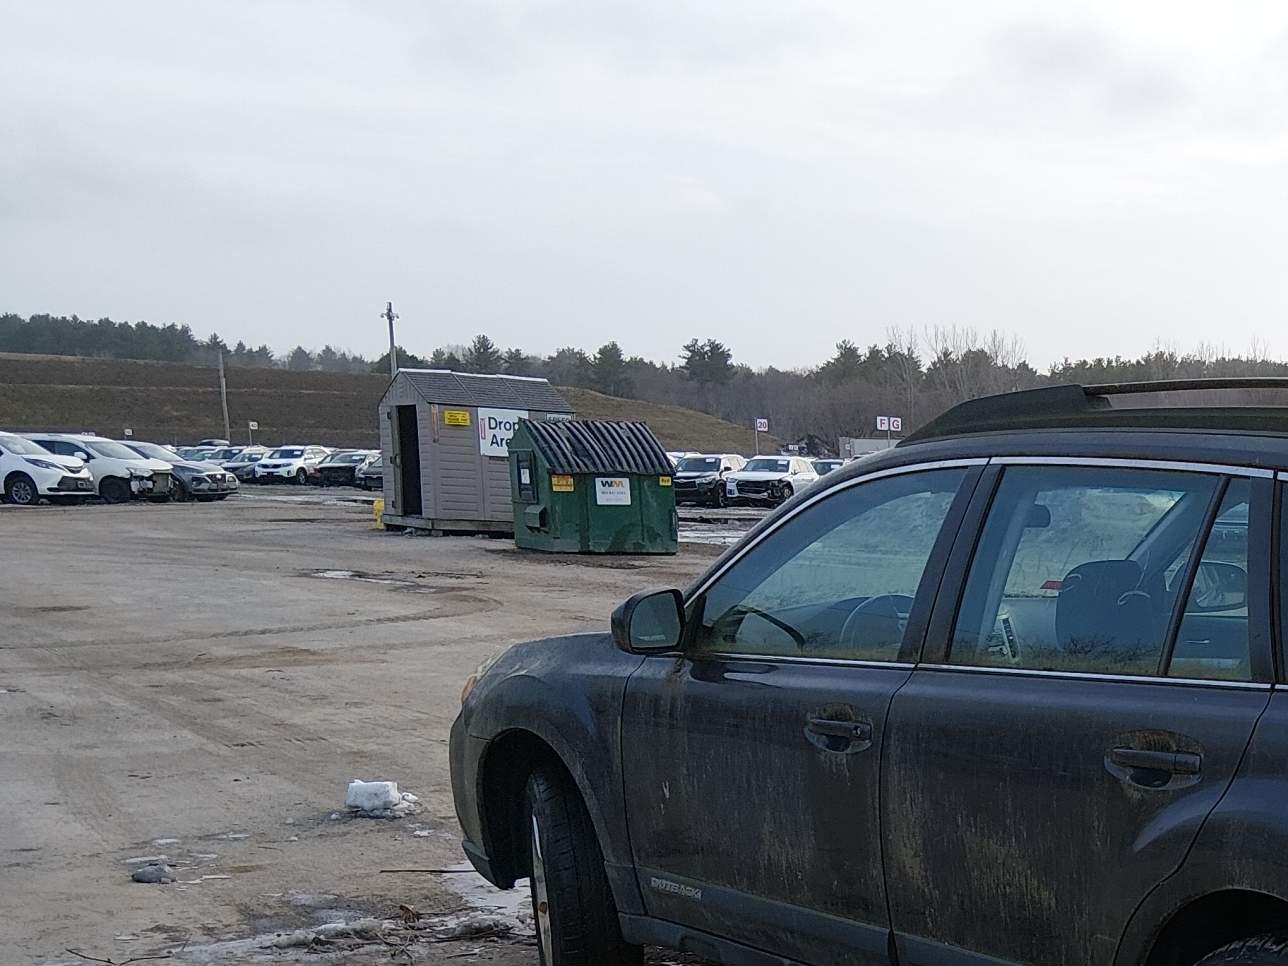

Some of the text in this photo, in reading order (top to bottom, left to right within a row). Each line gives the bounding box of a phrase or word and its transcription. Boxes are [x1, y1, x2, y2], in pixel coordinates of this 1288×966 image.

[487, 416, 520, 432] Drop
[758, 421, 767, 429] 20
[879, 418, 887, 429] F
[891, 419, 900, 429] G
[600, 479, 625, 489] WM
